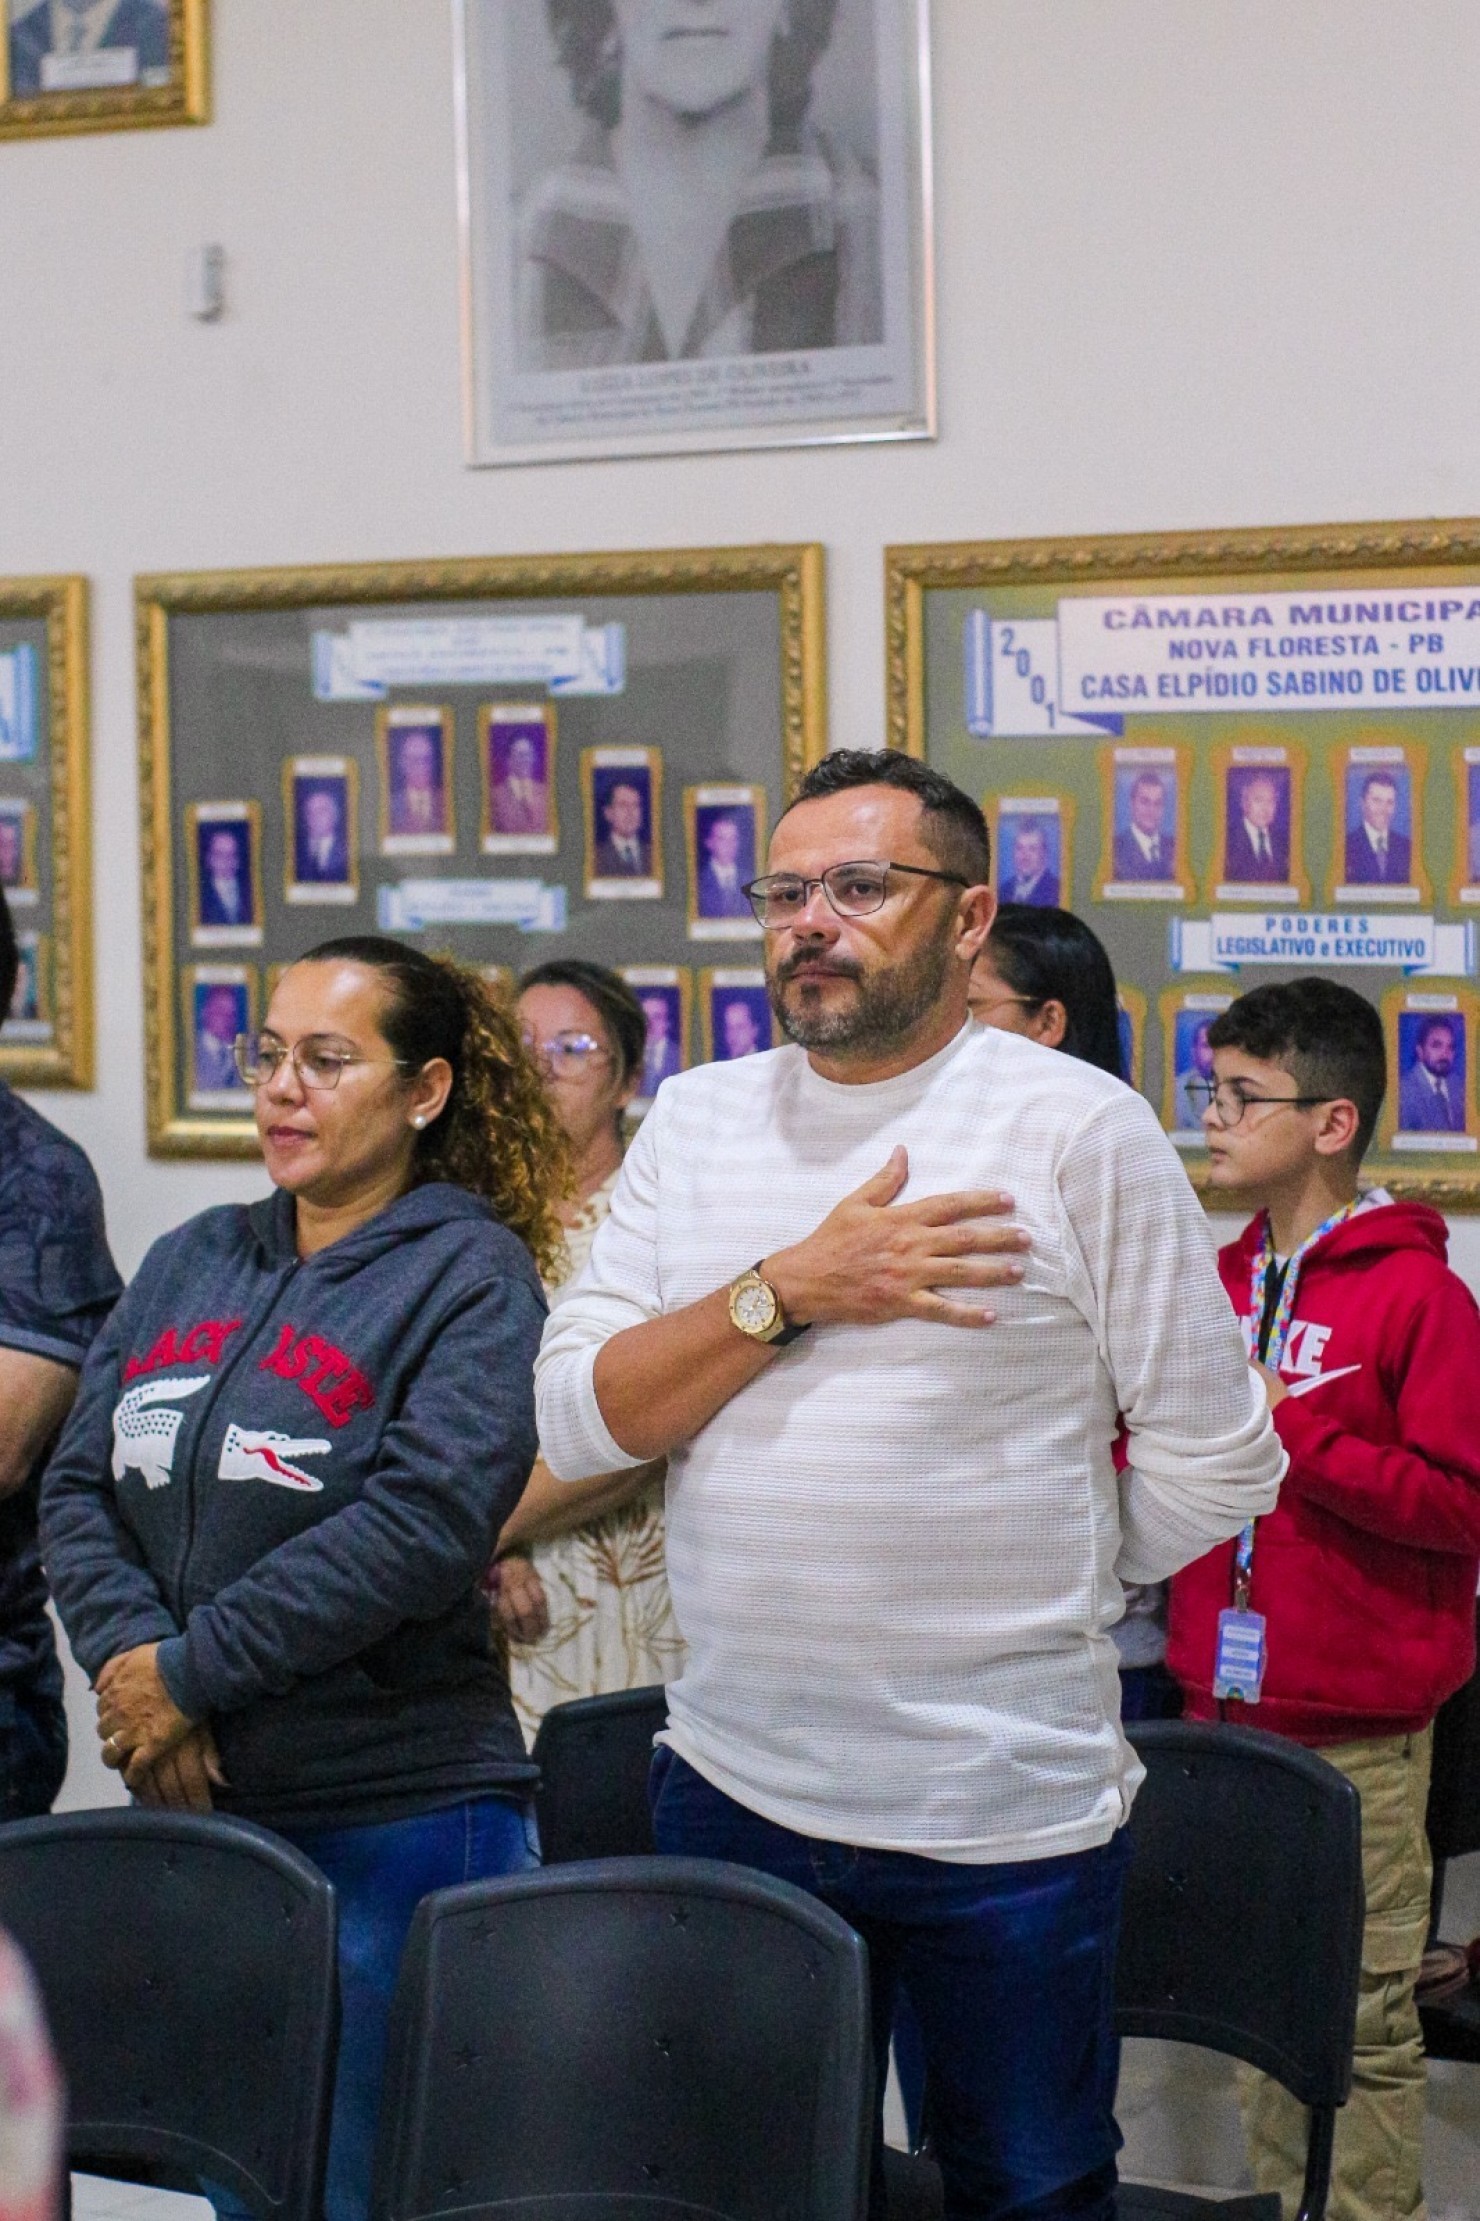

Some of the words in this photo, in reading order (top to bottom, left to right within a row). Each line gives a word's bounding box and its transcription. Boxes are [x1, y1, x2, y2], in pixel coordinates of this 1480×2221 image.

[1103, 604, 1274, 630] CÂMARA
[1169, 639, 1238, 659] NOVA
[1248, 634, 1380, 658] FLORESTA
[1408, 632, 1444, 653] PB
[1081, 673, 1149, 699] CASA
[1157, 666, 1258, 698] ELPÍDIO
[1266, 668, 1363, 697] SABINO
[1373, 668, 1407, 694] DE
[1416, 666, 1480, 693] OLIV
[1265, 916, 1369, 934] PODERES
[1216, 936, 1316, 957] LEGISLATIVO
[1320, 941, 1330, 957] e
[1335, 937, 1426, 958] EXECUTIVO
